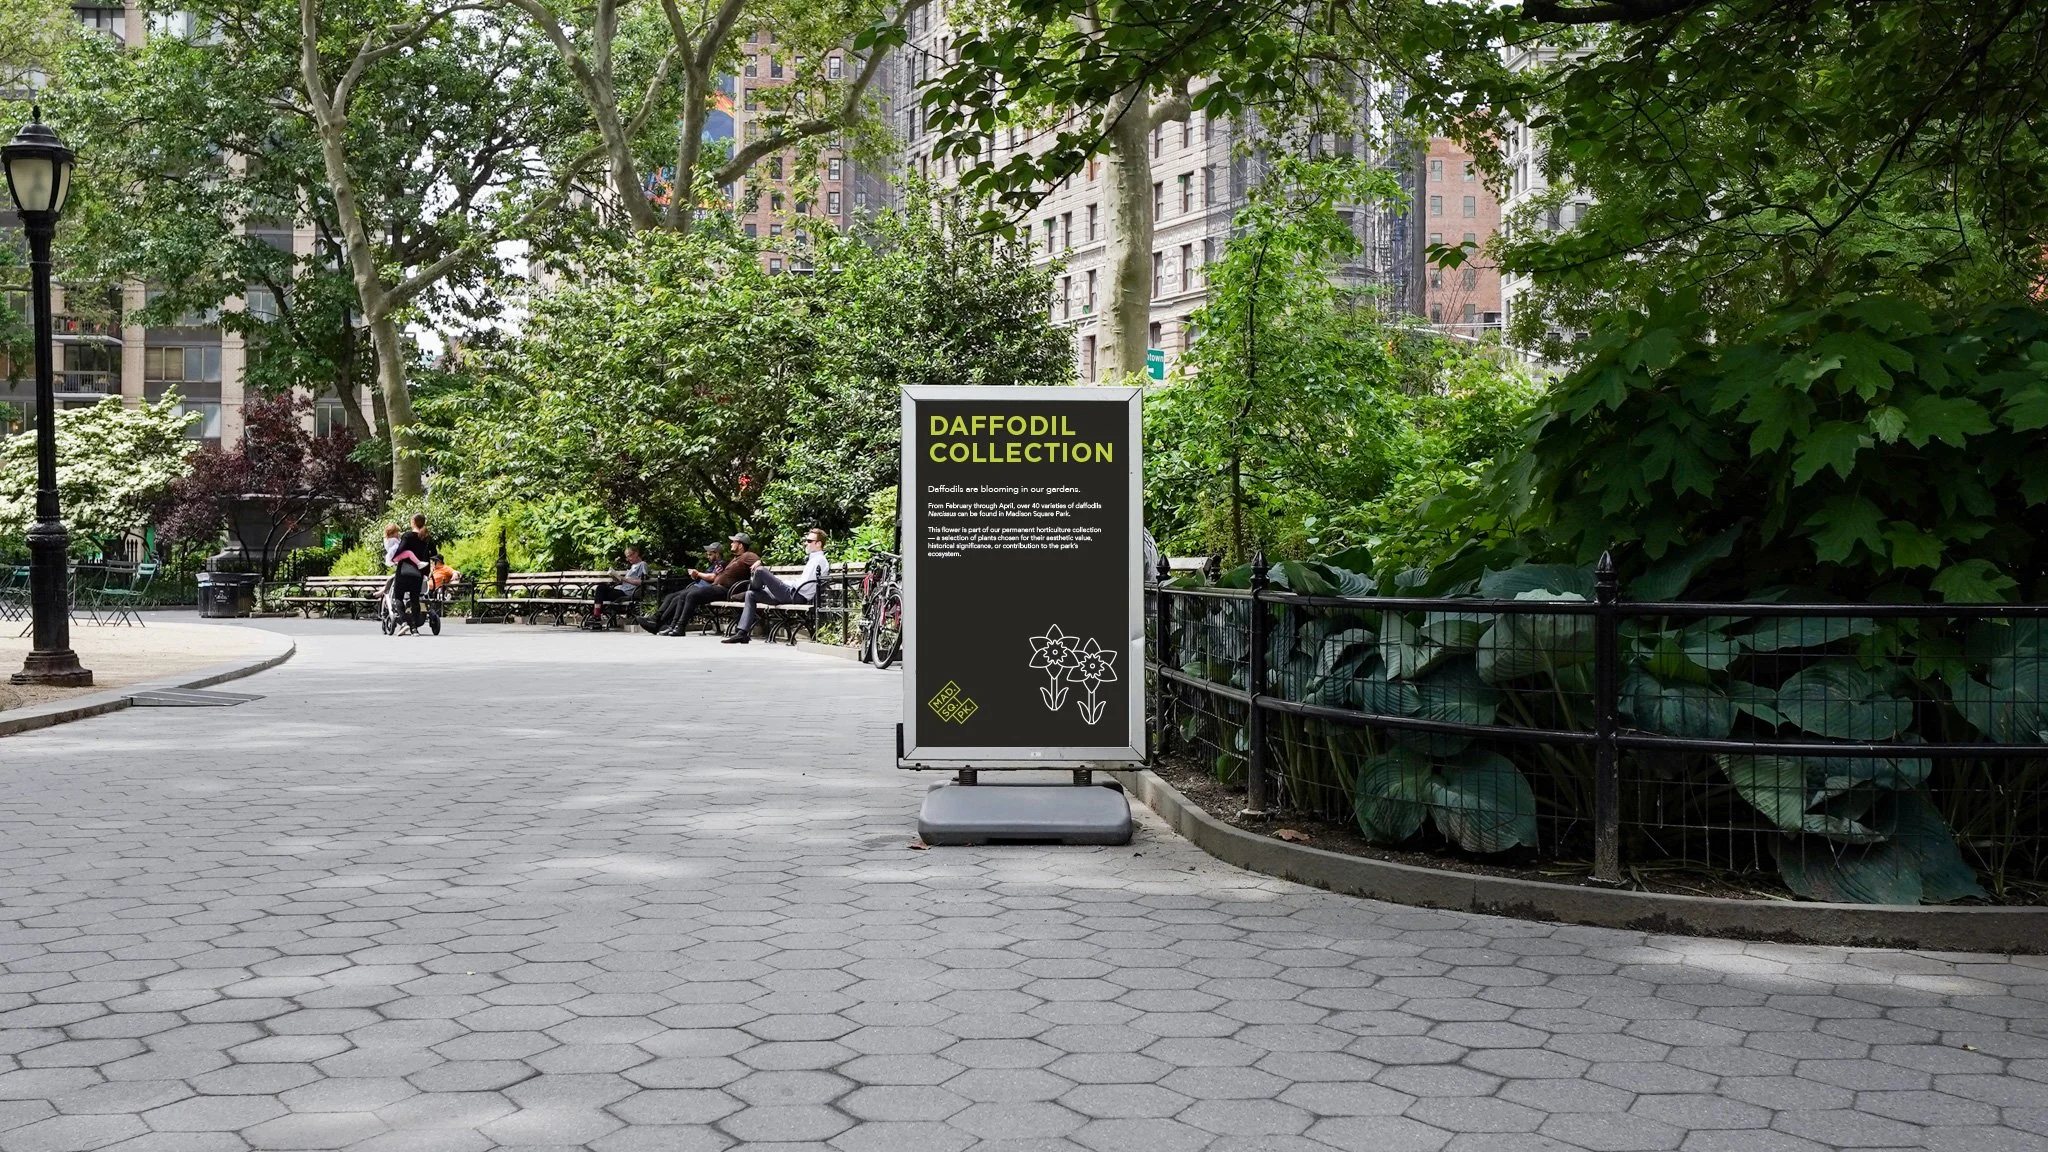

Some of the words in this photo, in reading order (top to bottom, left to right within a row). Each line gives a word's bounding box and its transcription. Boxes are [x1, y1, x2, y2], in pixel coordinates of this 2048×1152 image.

[930, 415, 1077, 436] DAFFODIL
[929, 442, 1113, 463] COLLECTION
[927, 484, 964, 493] Daffodils
[980, 484, 1019, 495] blooming
[1021, 485, 1029, 493] in
[1046, 484, 1081, 495] gardens.
[945, 502, 973, 511] February
[973, 502, 998, 511] through
[998, 502, 1016, 511] April,
[1075, 501, 1102, 509] daffodils
[1032, 510, 1055, 519] Square
[967, 526, 981, 535] part
[982, 525, 989, 533] of
[1001, 526, 1035, 535] permanent
[977, 534, 997, 542] plants
[1074, 534, 1093, 542] value,
[956, 542, 994, 550] significance,
[927, 551, 962, 559] ecosystem.
[932, 687, 957, 709] MAD.
[941, 703, 959, 718] SQ.
[956, 704, 974, 720] PK.
